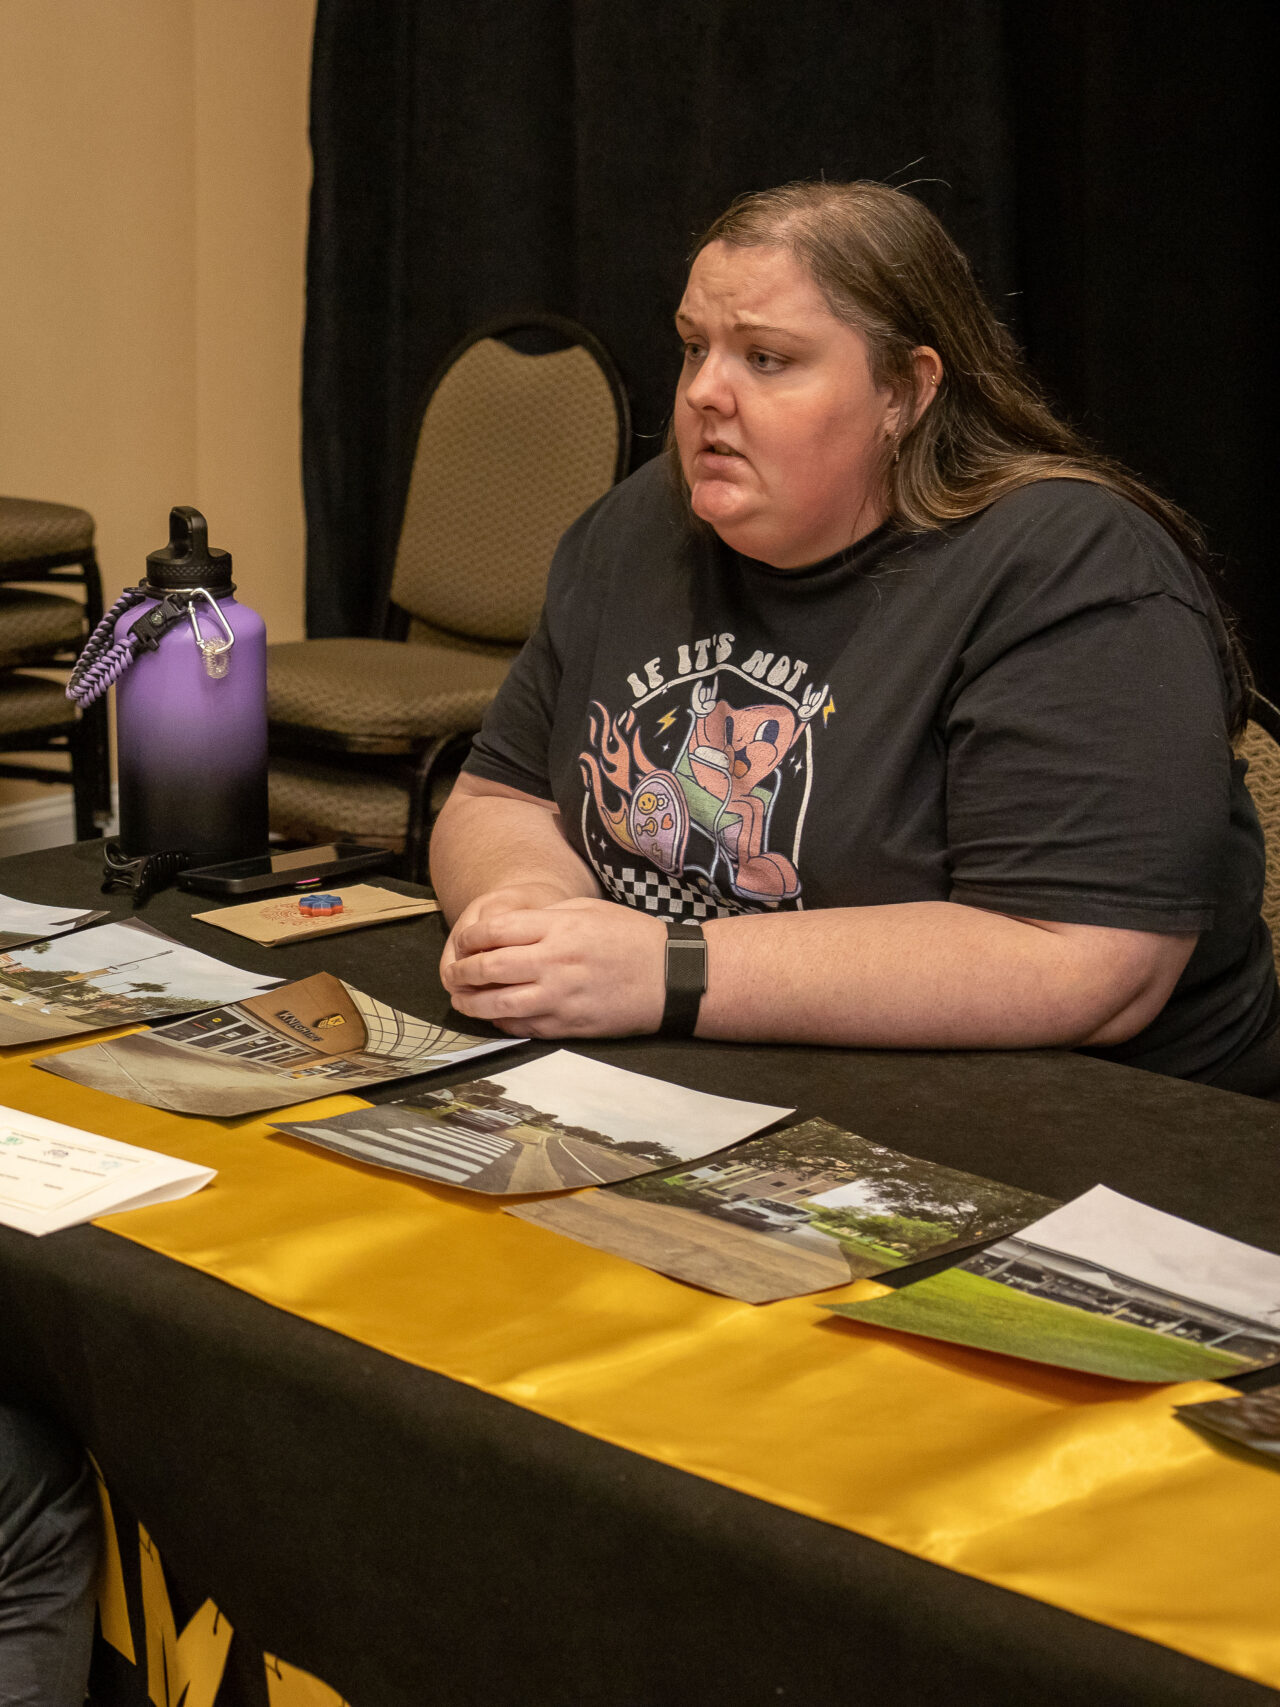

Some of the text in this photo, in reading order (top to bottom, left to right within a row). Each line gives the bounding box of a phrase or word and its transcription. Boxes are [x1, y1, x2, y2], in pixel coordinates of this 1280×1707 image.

[627, 632, 809, 698] IF IT'S NOT
